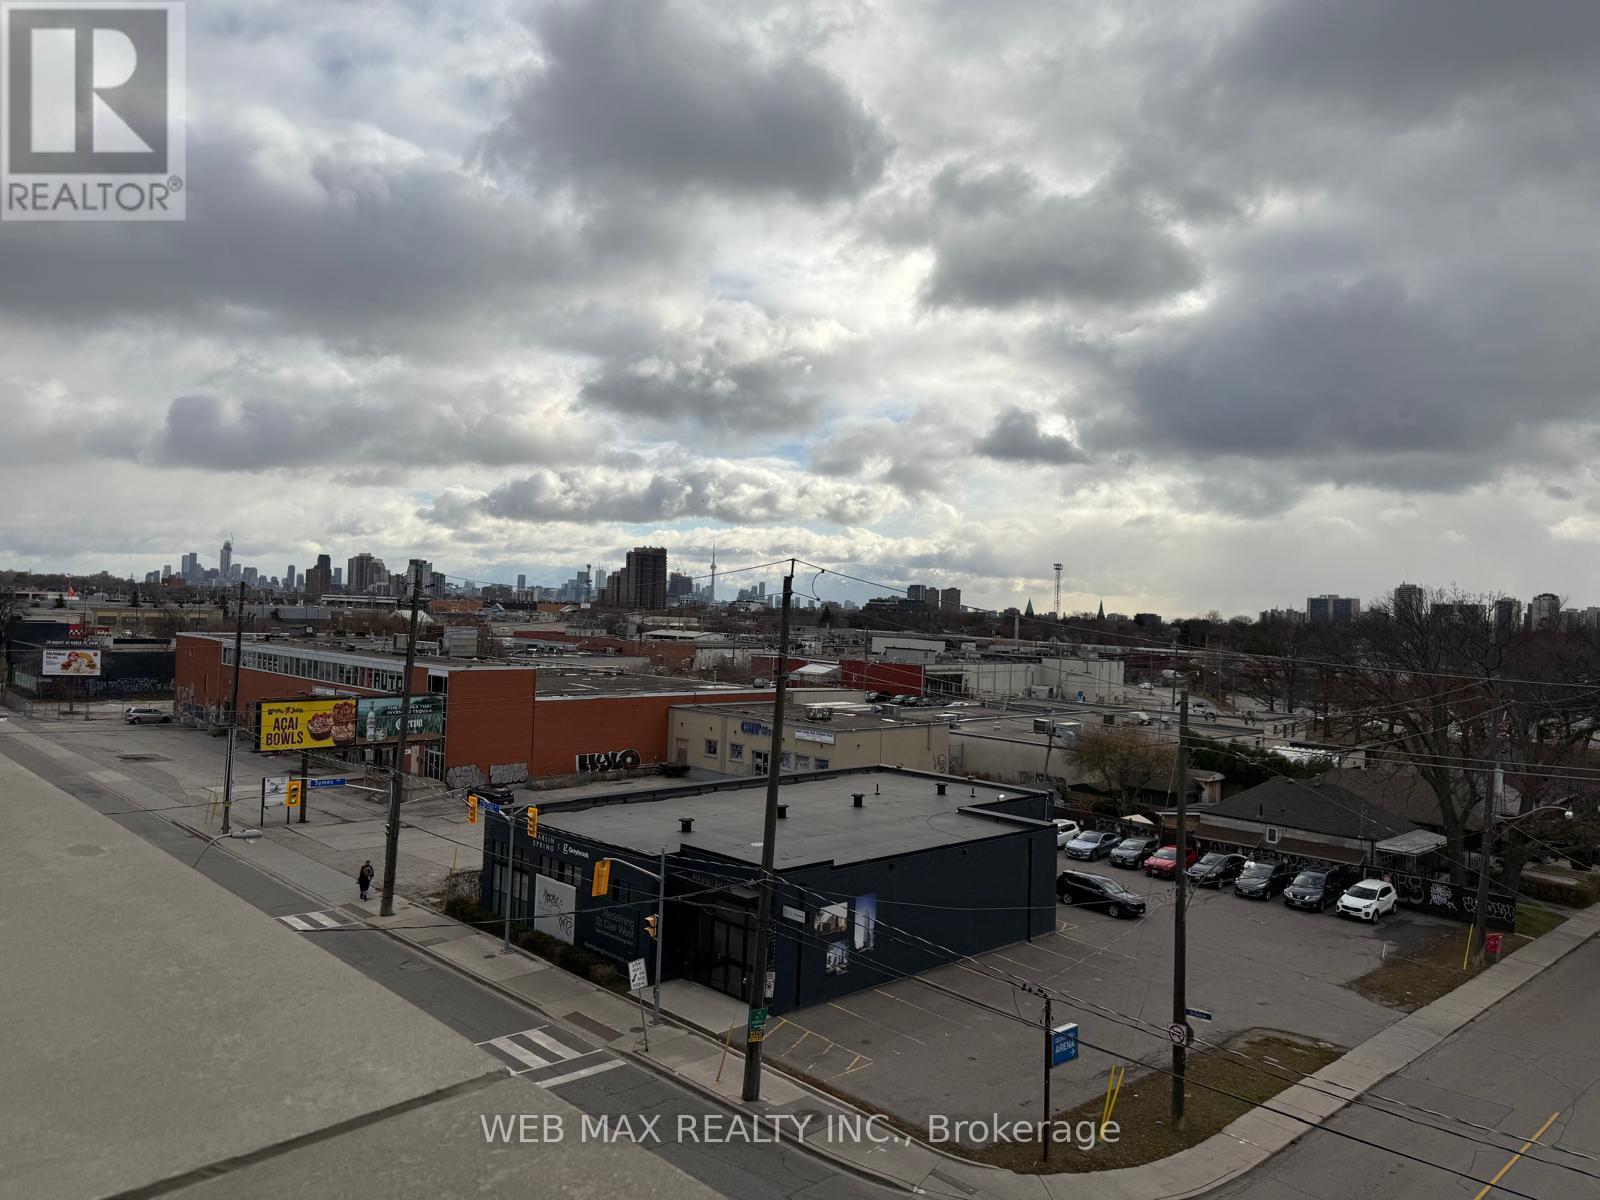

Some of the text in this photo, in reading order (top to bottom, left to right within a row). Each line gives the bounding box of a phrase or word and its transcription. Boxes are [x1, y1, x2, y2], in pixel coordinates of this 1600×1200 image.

[273, 717, 299, 734] AÇAI
[265, 731, 304, 747] BOWLS
[1055, 1039, 1075, 1055] ARENA
